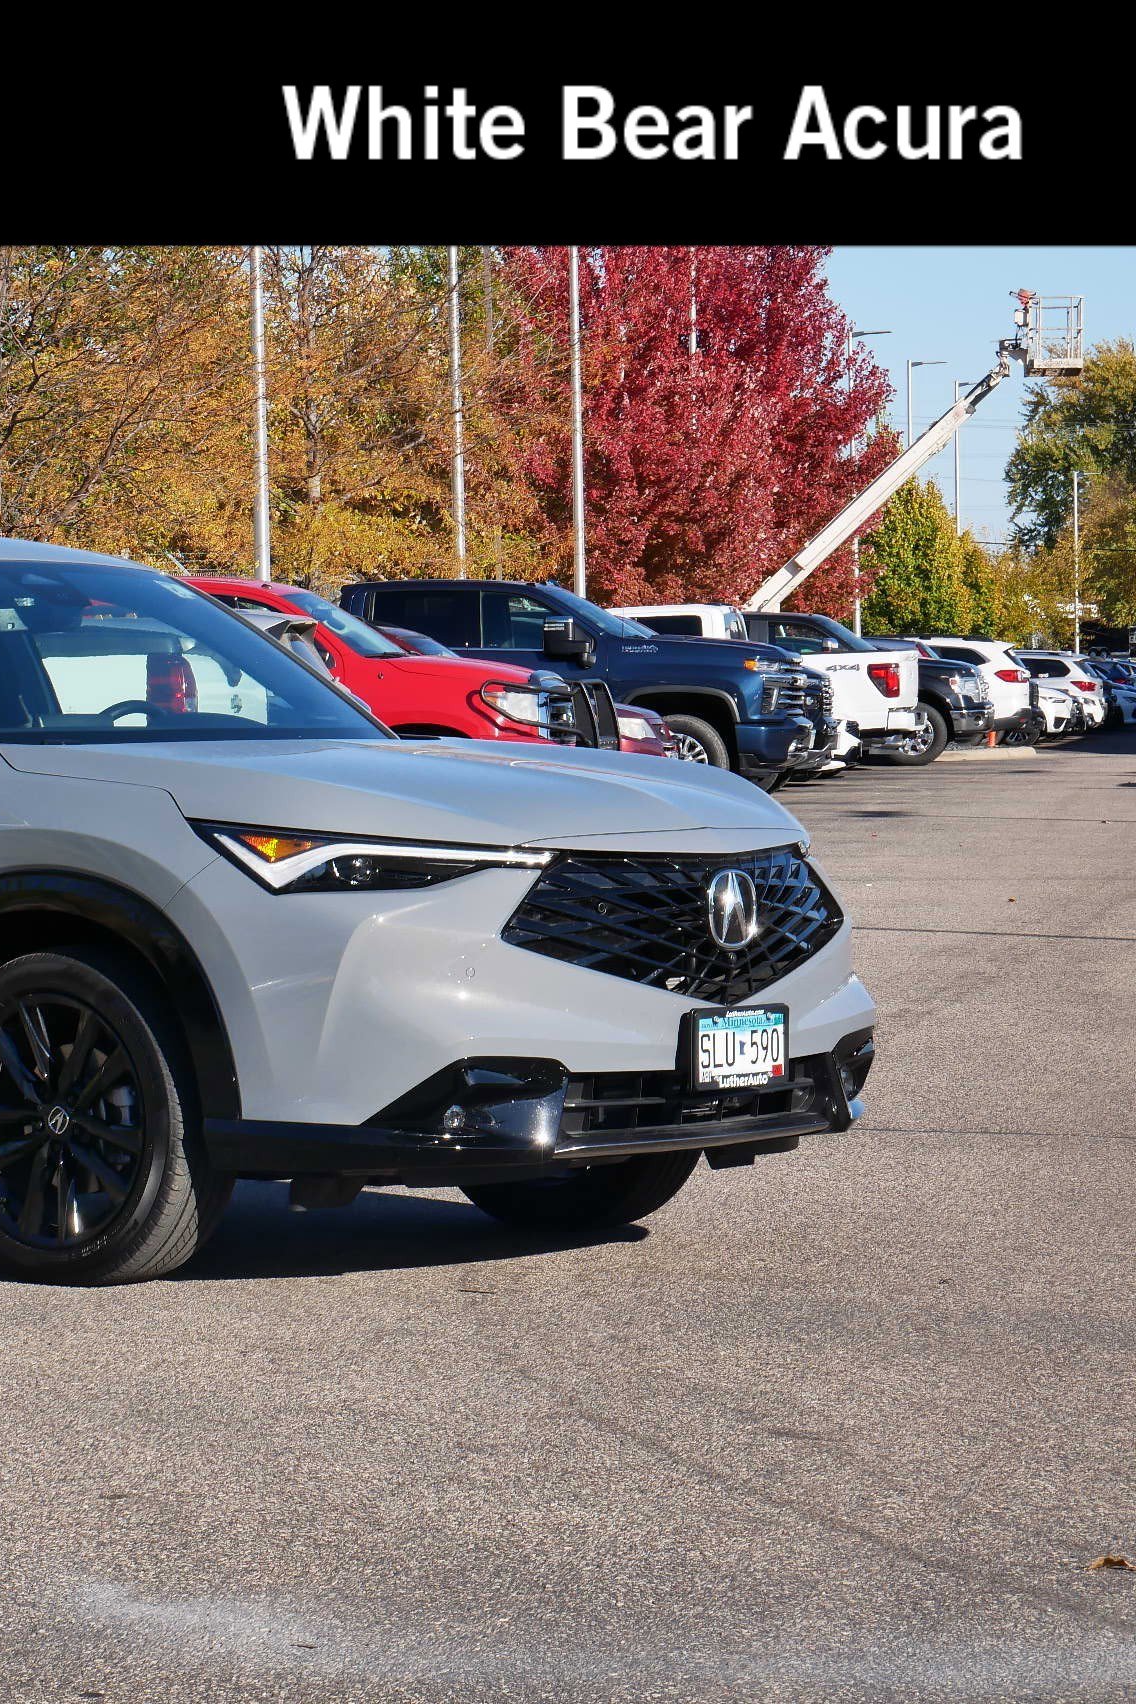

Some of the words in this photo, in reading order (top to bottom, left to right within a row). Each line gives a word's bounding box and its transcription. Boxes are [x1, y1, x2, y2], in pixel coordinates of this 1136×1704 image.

[700, 1031, 736, 1069] SLU
[750, 1028, 780, 1064] 590
[718, 1073, 769, 1088] LutherAuto
